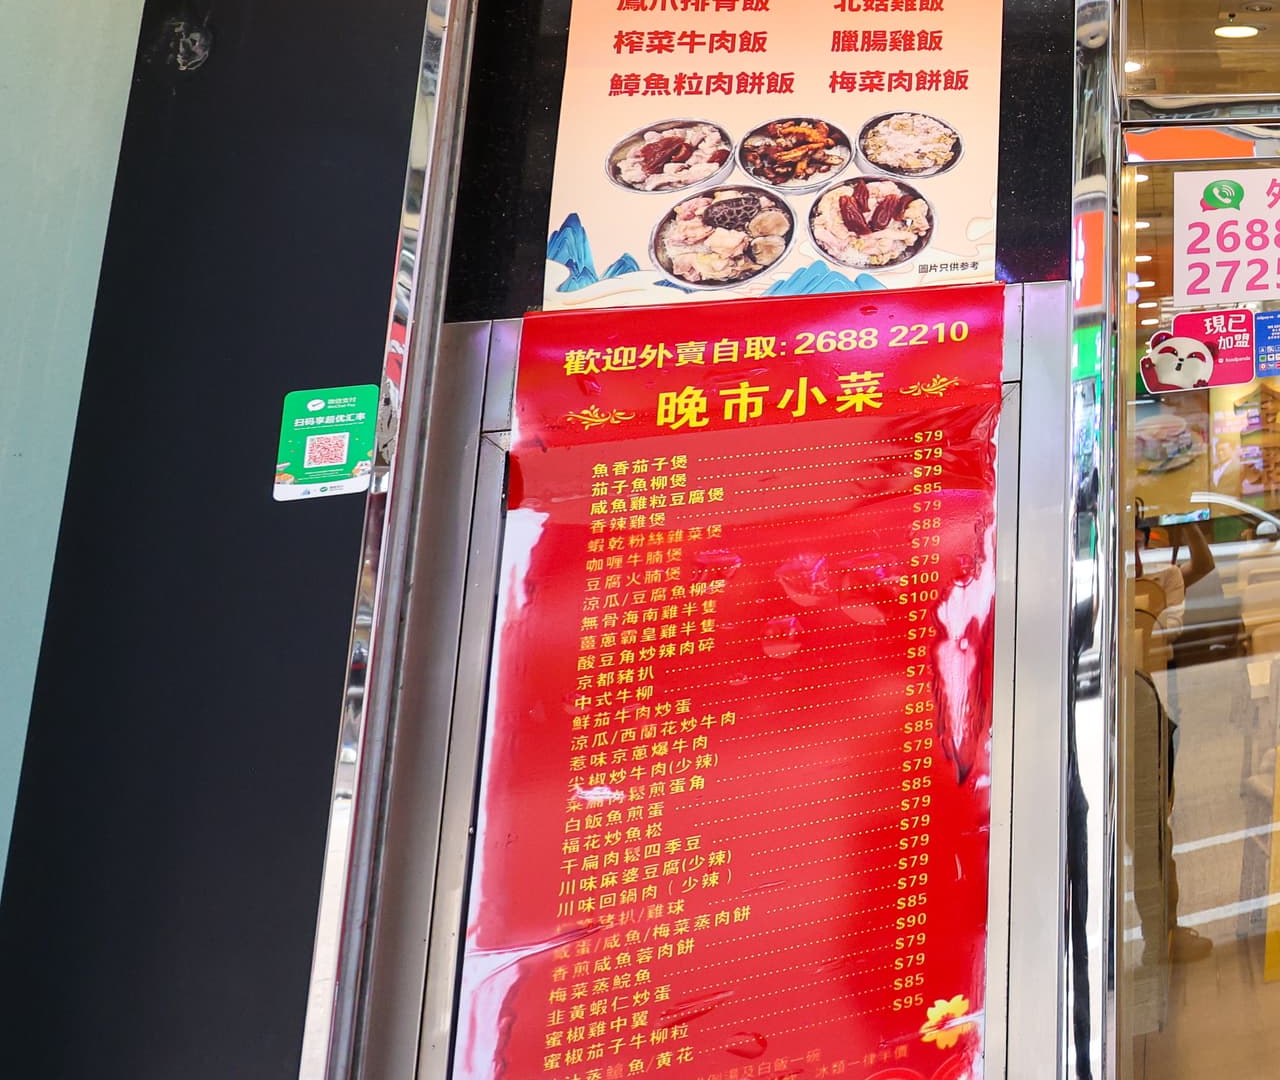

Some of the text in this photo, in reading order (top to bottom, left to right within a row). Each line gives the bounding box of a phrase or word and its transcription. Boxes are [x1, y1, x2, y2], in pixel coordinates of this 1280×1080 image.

[613, 30, 768, 54] 榨菜牛肉飯
[829, 69, 969, 94] 梅菜肉餅飯
[794, 327, 878, 356] 2688
[888, 321, 969, 348] 2210
[1203, 314, 1248, 335] 現已
[1217, 333, 1250, 350] 加盟
[656, 371, 884, 430] 晚市小菜
[592, 430, 943, 479] 魚香茄子煲 $79
[592, 447, 943, 497] 茄子魚柳煲 $79
[590, 465, 943, 516] 咸魚雞粒豆腐煲 $79
[590, 482, 942, 535] 香辣雞煲 $85
[912, 500, 942, 514] $79
[911, 517, 942, 532] $88
[910, 553, 940, 568] $79
[581, 571, 940, 631] 無骨海南雞半隻 $100
[898, 589, 939, 606] $100
[577, 638, 715, 671] 酸豆角炒辣肉碎
[576, 666, 655, 691] 京都豬扒
[574, 685, 654, 710] 中式牛柳
[903, 720, 934, 734] $85
[565, 757, 932, 833] 白飯魚煎蛋 $79
[896, 892, 928, 910] $85
[549, 912, 927, 1005] 梅菜蒸鯇魚 $90
[543, 1023, 689, 1071] 蜜椒茄子牛柳粒
[893, 973, 924, 990] $85
[544, 1010, 649, 1049] 蜜椒雞中翼
